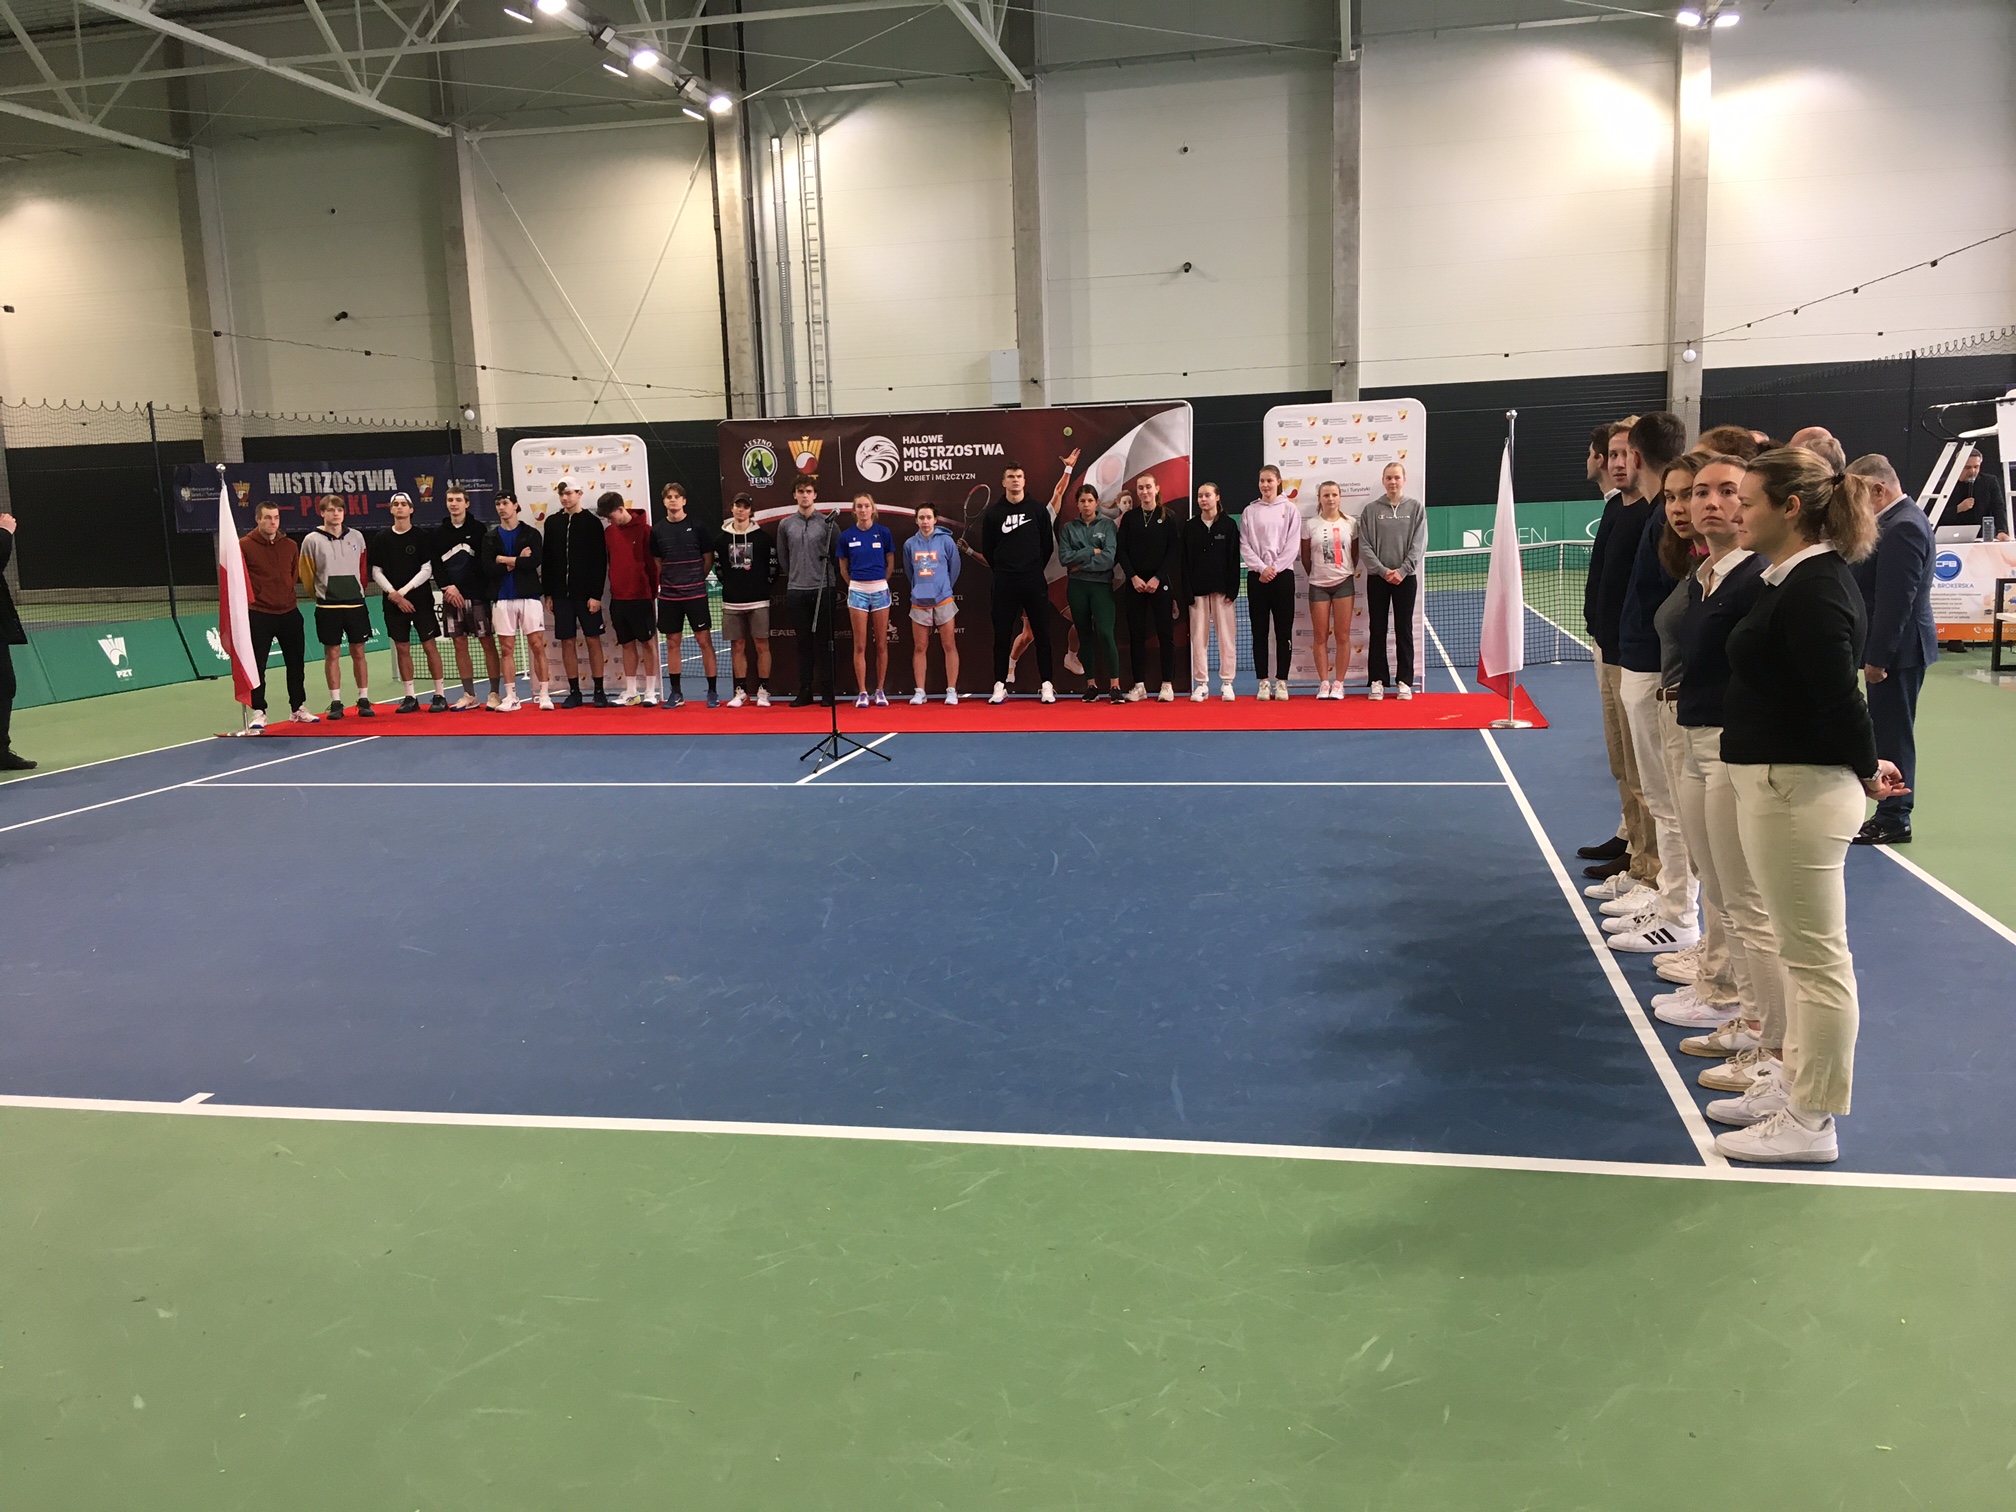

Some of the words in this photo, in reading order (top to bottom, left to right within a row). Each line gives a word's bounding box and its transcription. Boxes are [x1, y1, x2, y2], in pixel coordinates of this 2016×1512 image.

[744, 438, 773, 449] LESZNO
[902, 434, 944, 444] HALOWE
[903, 443, 1005, 459] MISTRZOSTWA
[903, 459, 953, 472] POLSKI
[268, 468, 398, 495] MISTRZOSTWA
[750, 476, 773, 484] TENIS
[904, 474, 930, 482] KOBIET
[935, 472, 976, 482] MĘŻCZYZN
[300, 494, 369, 517] POKI
[1484, 526, 1547, 546] OEN
[116, 668, 133, 678] PZT
